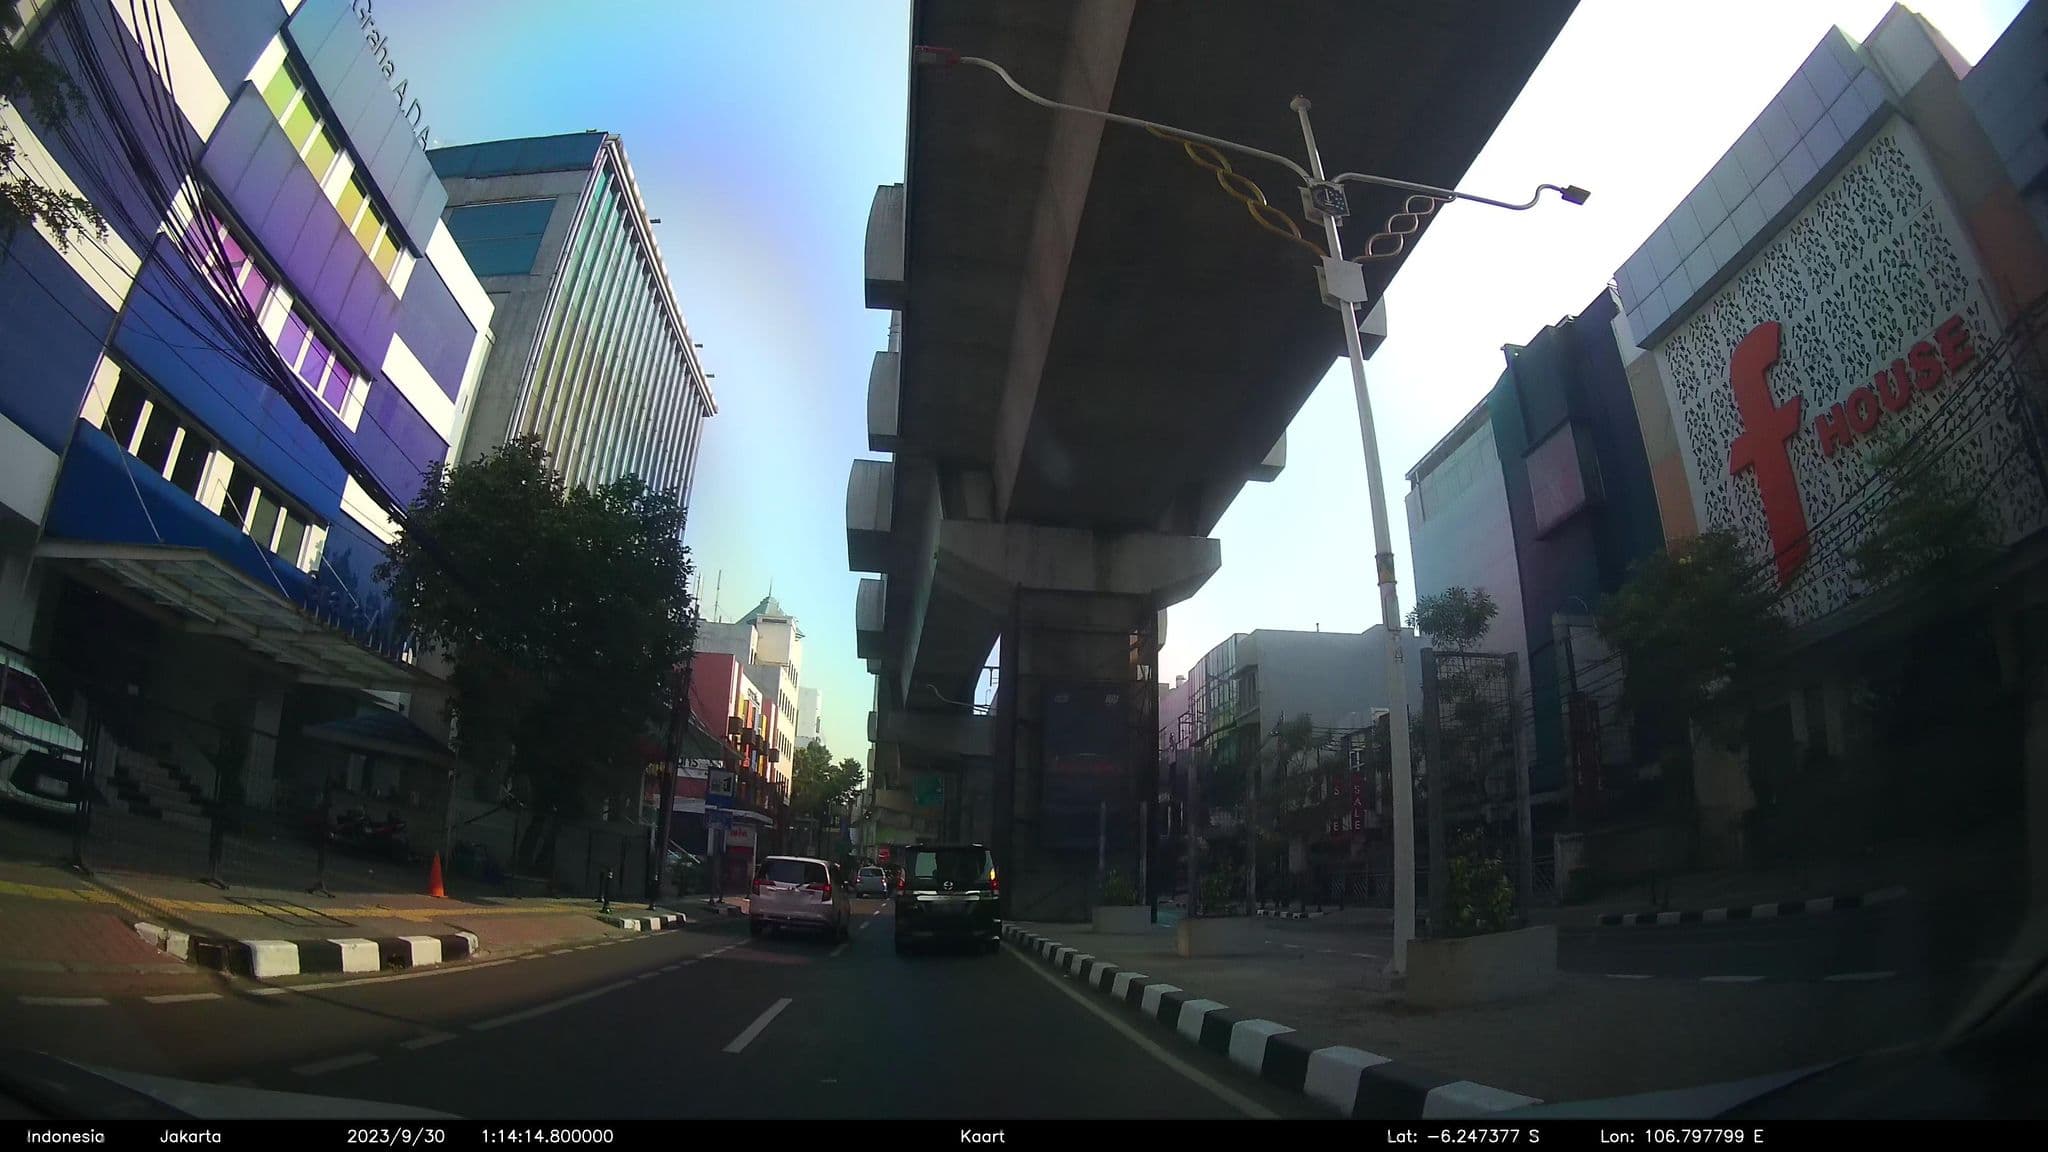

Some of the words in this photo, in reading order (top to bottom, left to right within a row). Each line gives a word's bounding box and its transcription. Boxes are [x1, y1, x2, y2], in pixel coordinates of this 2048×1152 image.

[392, 79, 431, 152] ADA
[1730, 320, 1810, 587] f
[1814, 314, 1976, 458] HOUSE
[1352, 784, 1362, 830] SALE
